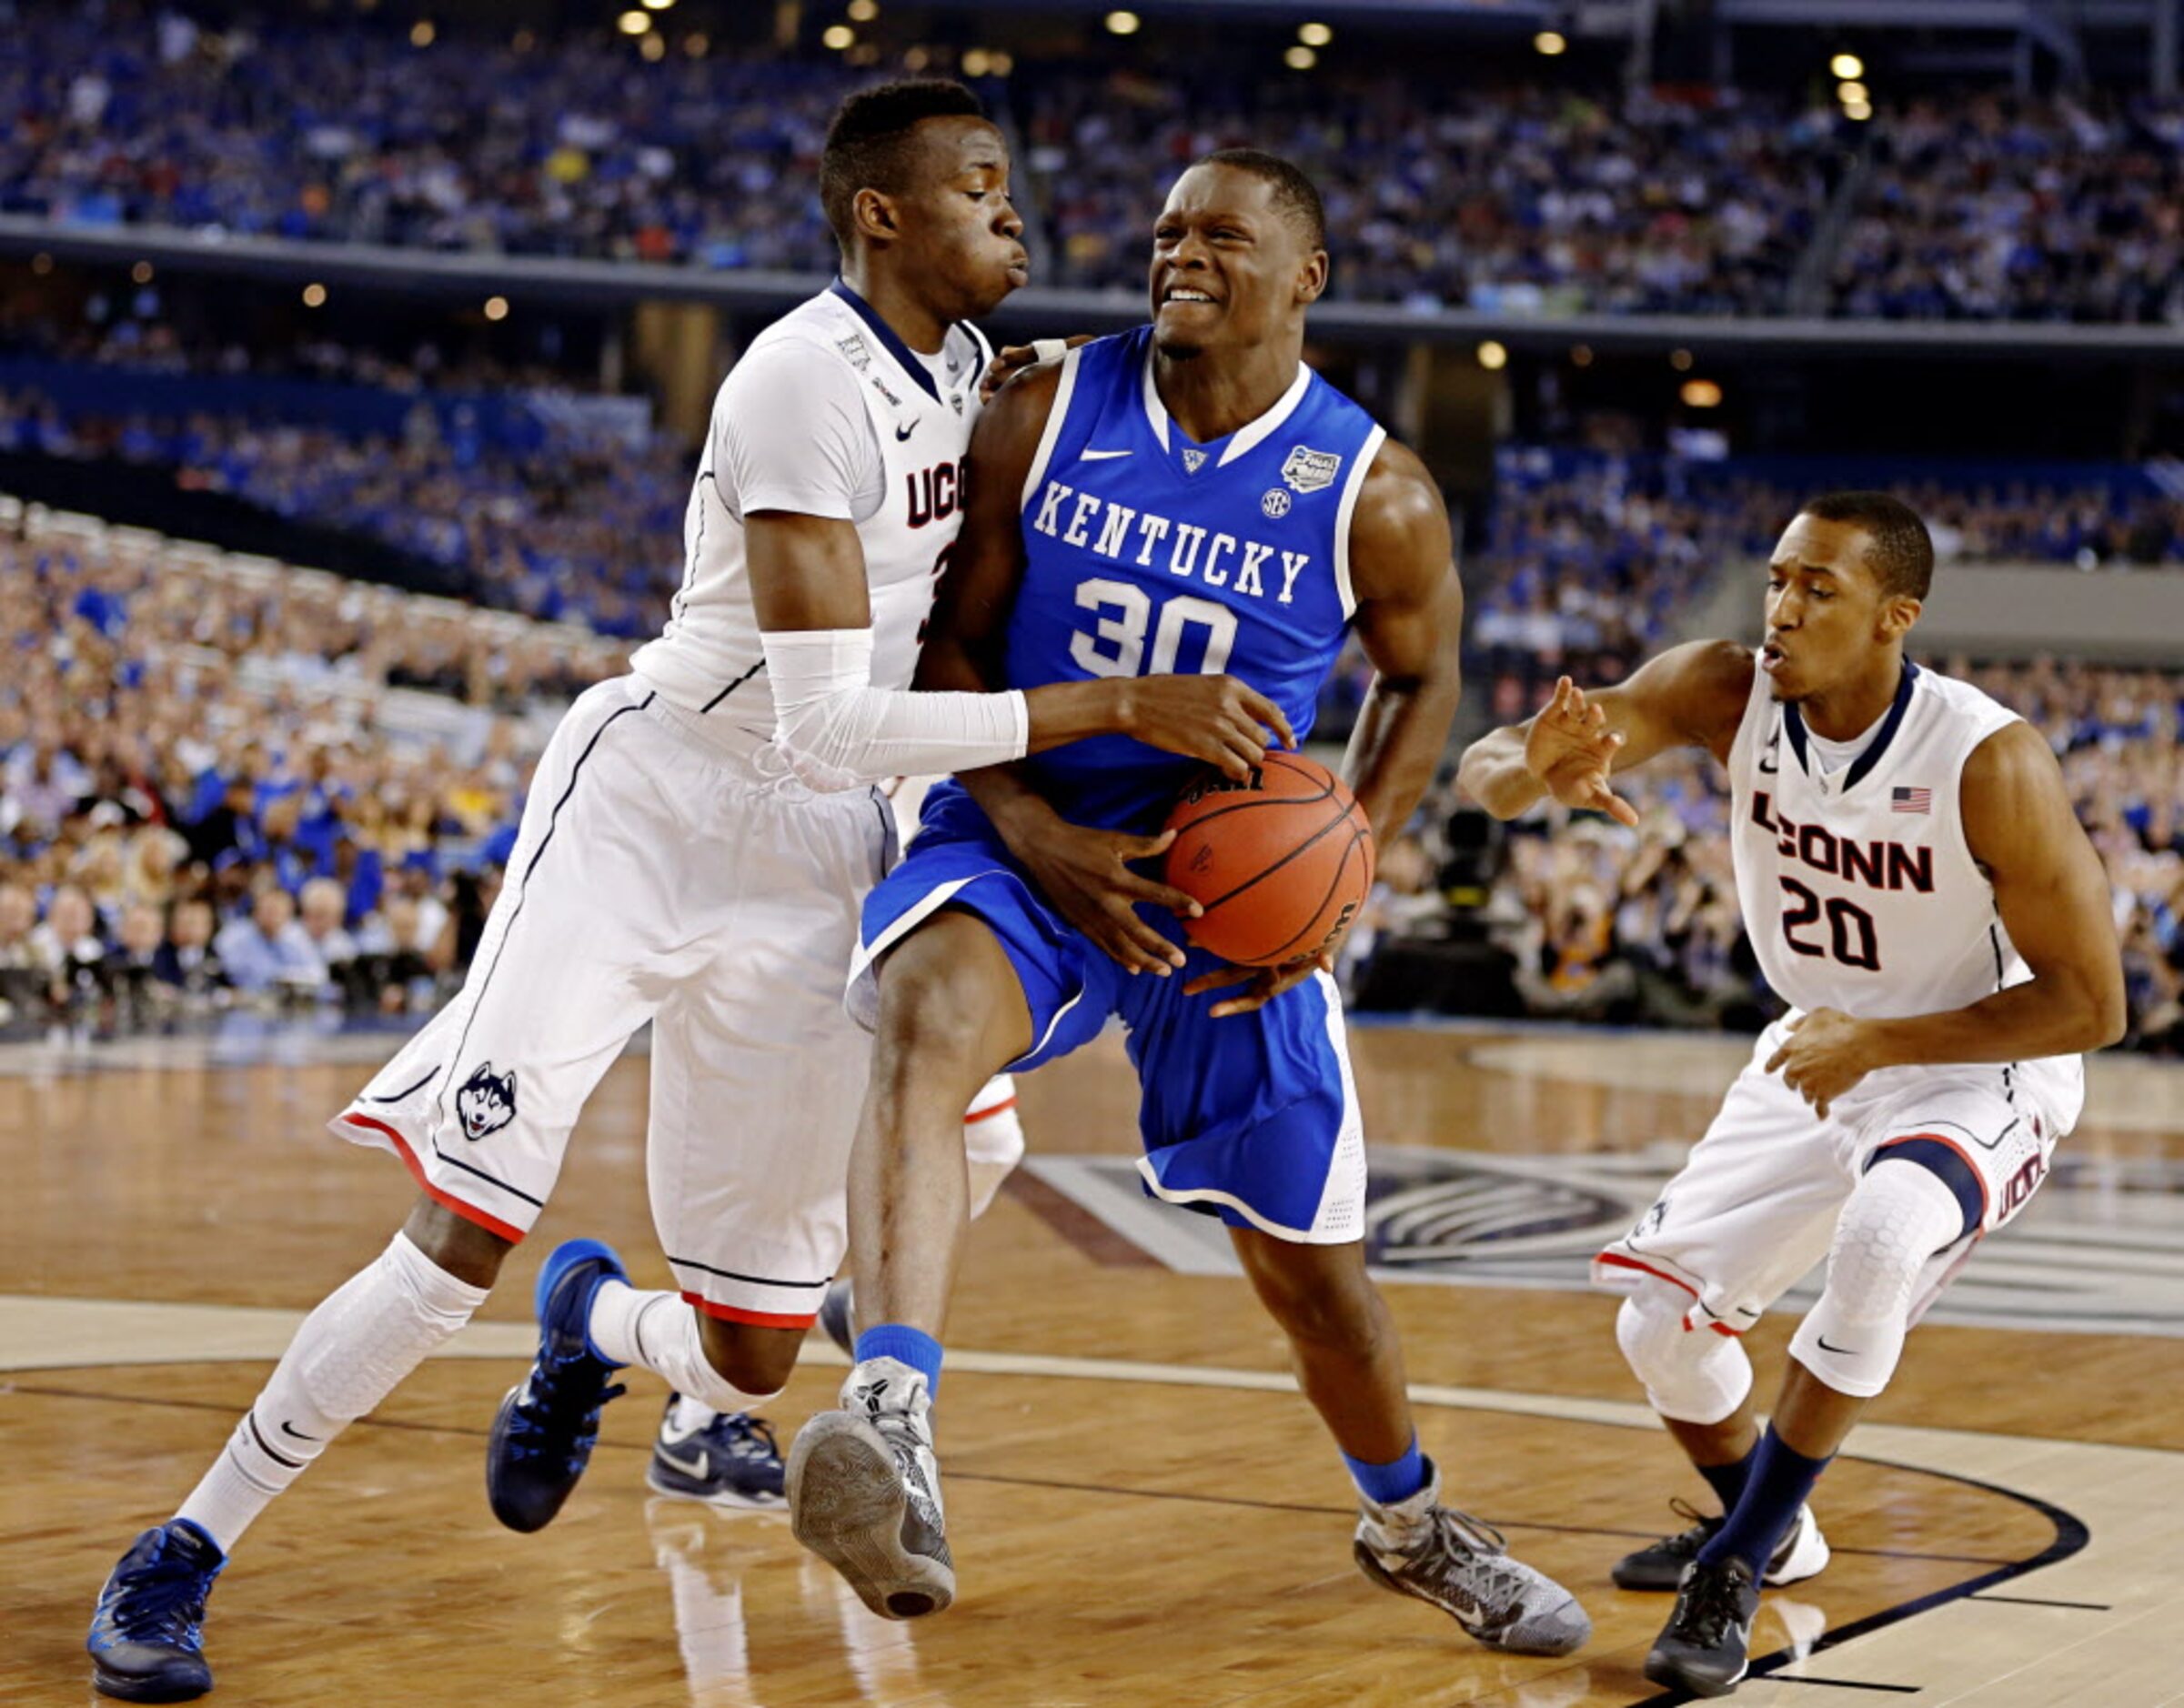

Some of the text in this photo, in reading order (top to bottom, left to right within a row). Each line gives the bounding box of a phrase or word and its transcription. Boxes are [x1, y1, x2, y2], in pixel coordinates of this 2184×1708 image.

[1034, 480, 1310, 604] KENTUCKY
[1263, 489, 1290, 517] SEC
[1069, 578, 1238, 678] 30
[1778, 874, 1881, 971] 20
